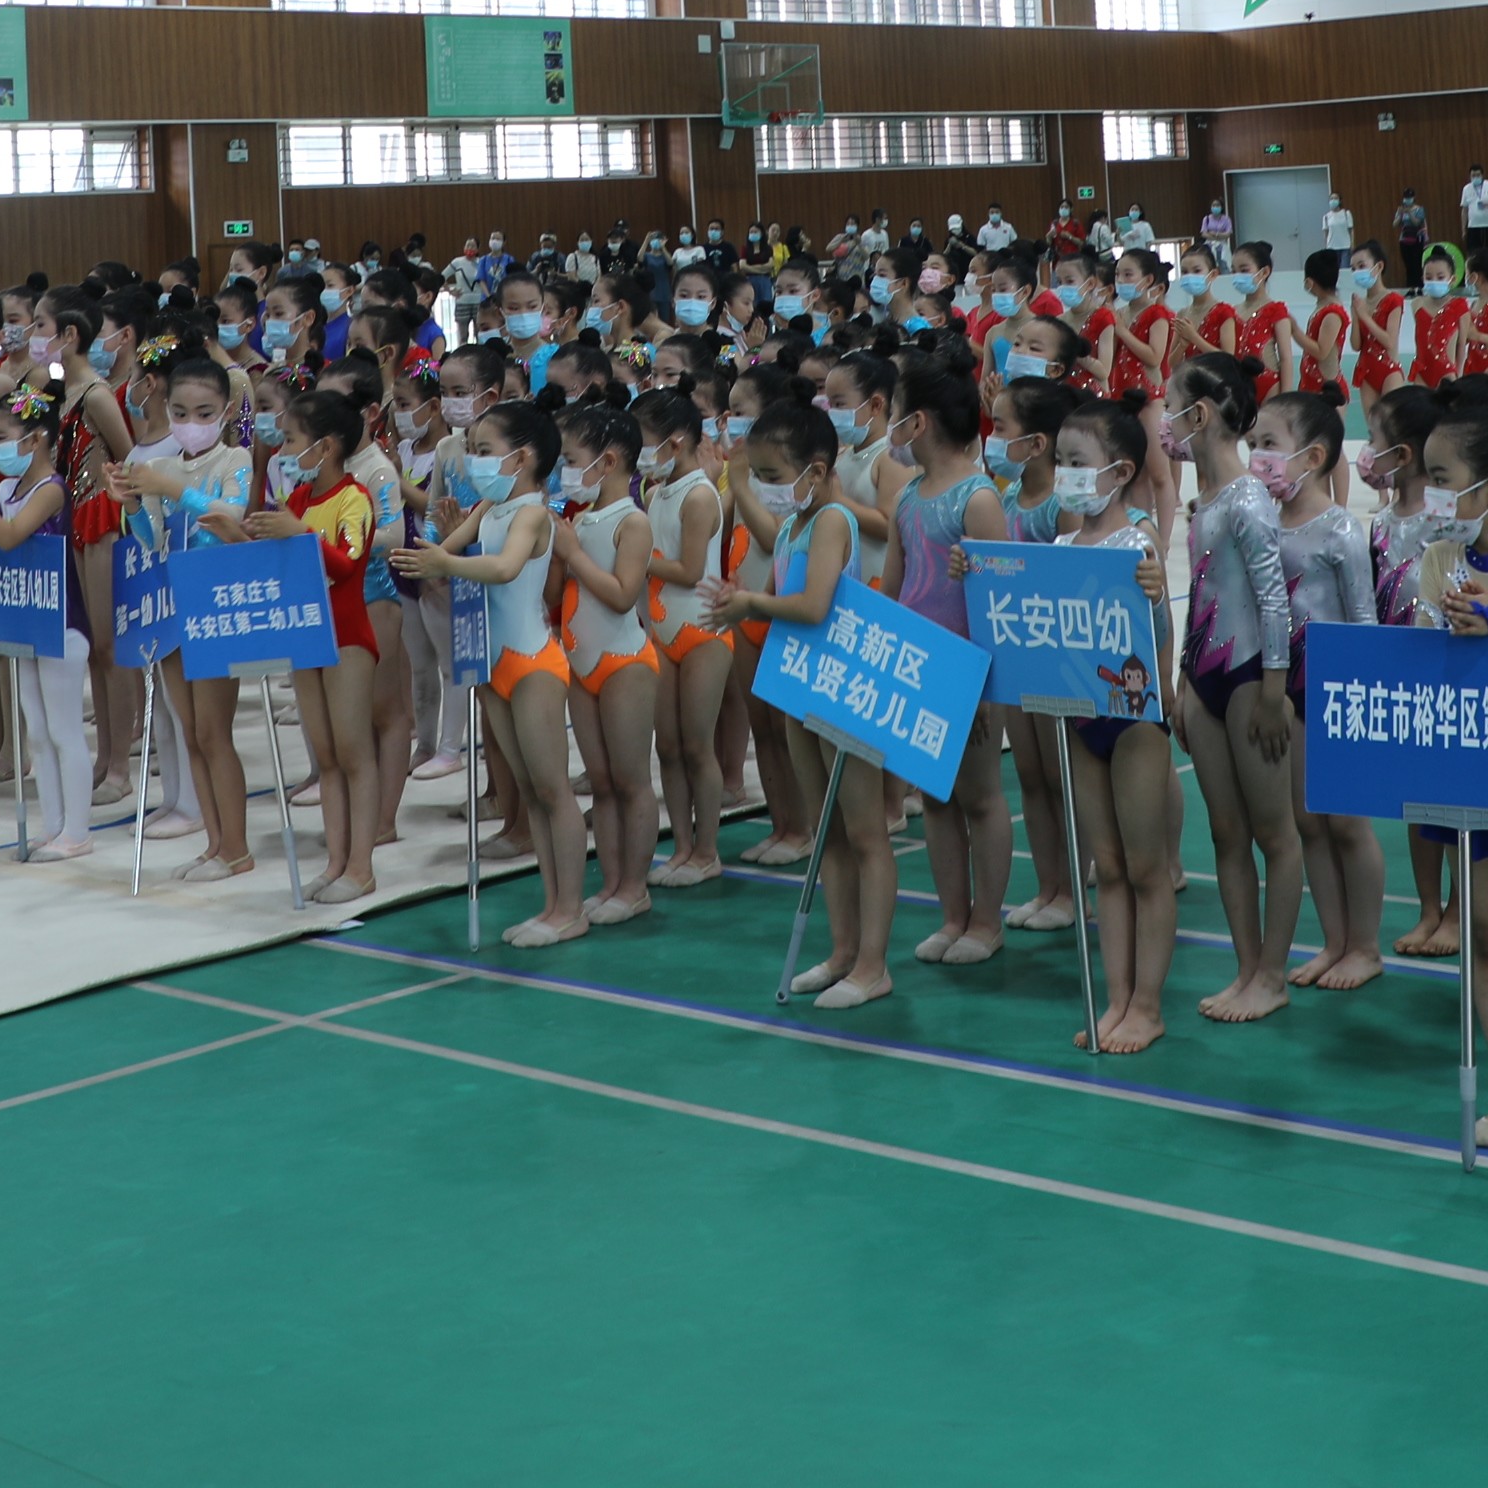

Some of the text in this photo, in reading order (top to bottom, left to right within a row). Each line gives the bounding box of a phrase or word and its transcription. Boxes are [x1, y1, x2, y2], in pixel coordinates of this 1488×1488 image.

[116, 586, 176, 636] 第一幼儿
[184, 603, 322, 641] 长安区第二幼儿园
[212, 578, 281, 608] 石家庄市
[826, 605, 929, 690] 高新区
[986, 590, 1133, 656] 长安四幼
[780, 636, 949, 760] 弘贤幼儿园
